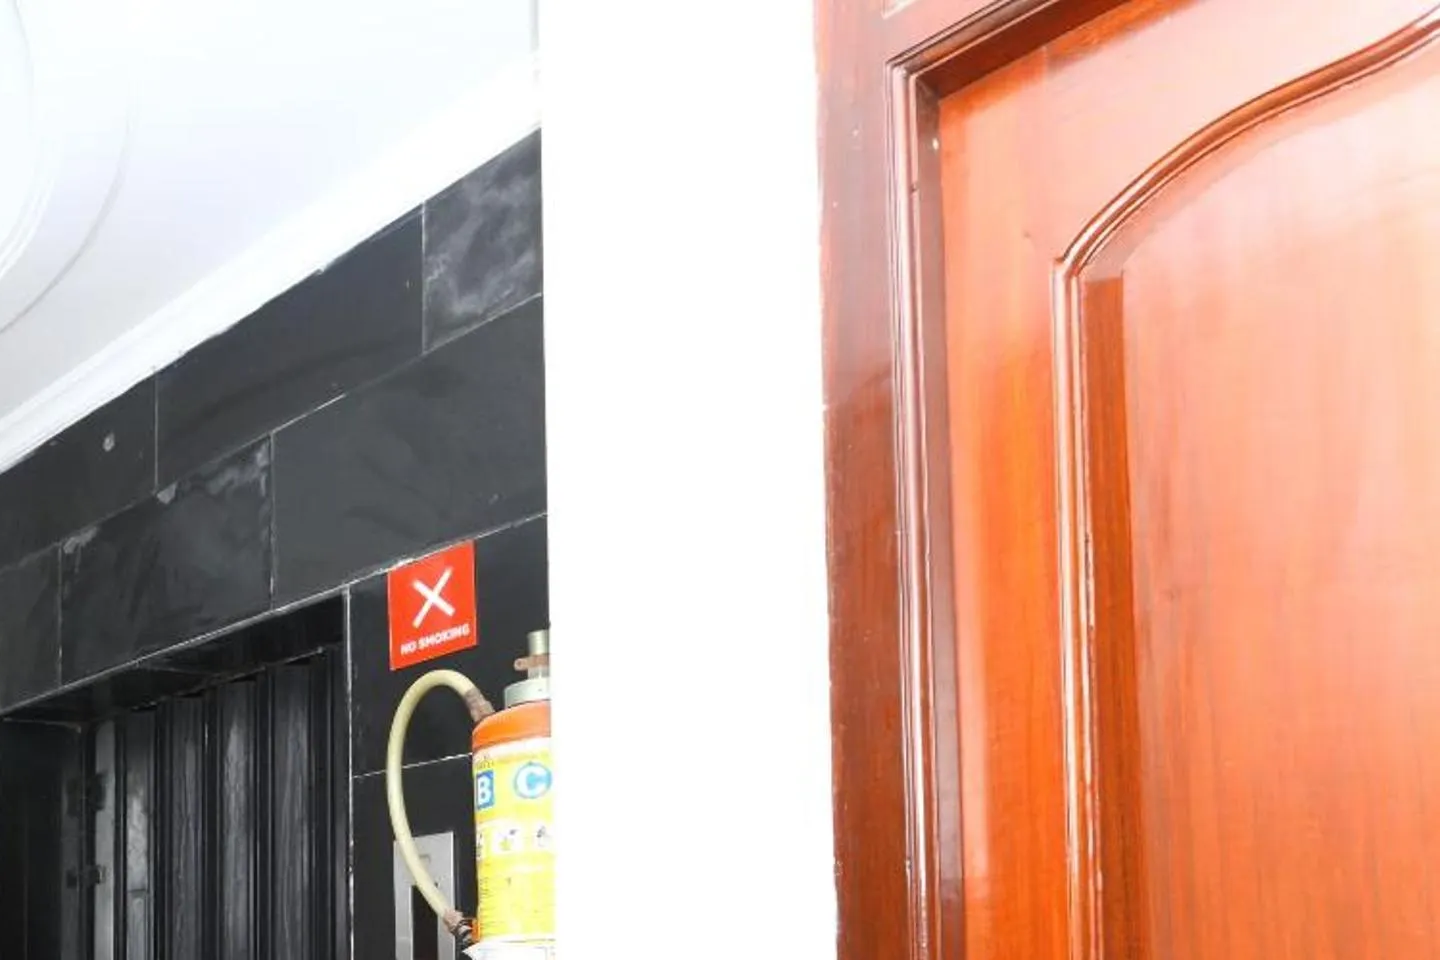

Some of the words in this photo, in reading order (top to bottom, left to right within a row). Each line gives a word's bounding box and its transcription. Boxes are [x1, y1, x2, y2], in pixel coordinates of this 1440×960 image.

[400, 638, 417, 656] NO
[418, 623, 470, 650] SMOKING
[477, 775, 493, 807] B
[516, 764, 550, 798] C
